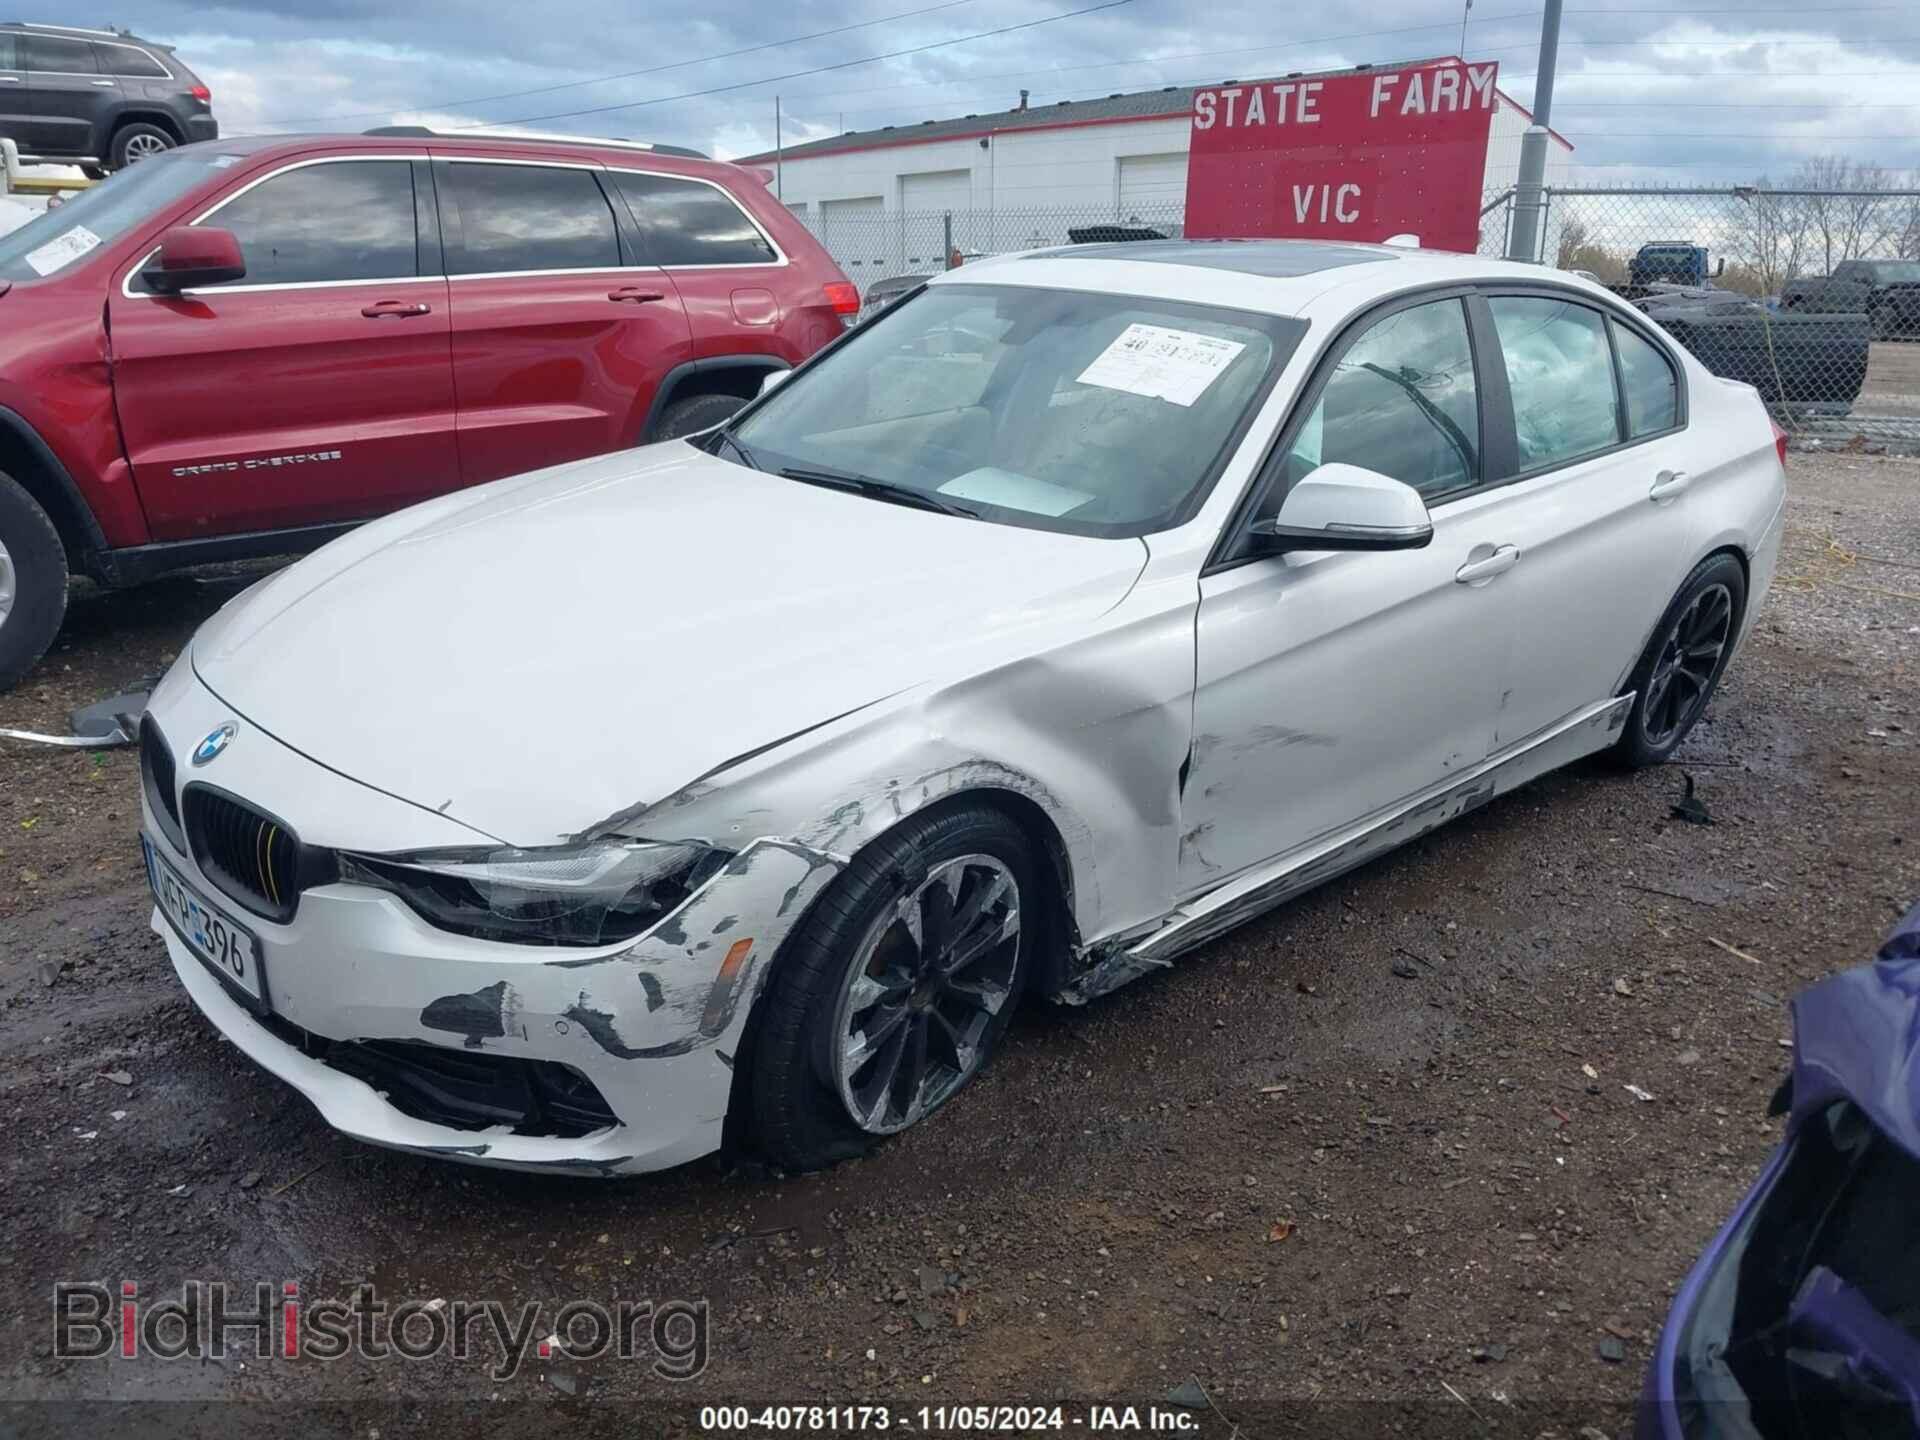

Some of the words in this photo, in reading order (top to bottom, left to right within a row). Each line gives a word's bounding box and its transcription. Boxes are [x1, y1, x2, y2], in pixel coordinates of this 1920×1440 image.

[1194, 82, 1324, 130] STATE
[1370, 64, 1496, 118] FARM
[1292, 183, 1361, 224] VIC
[198, 907, 245, 979] 396
